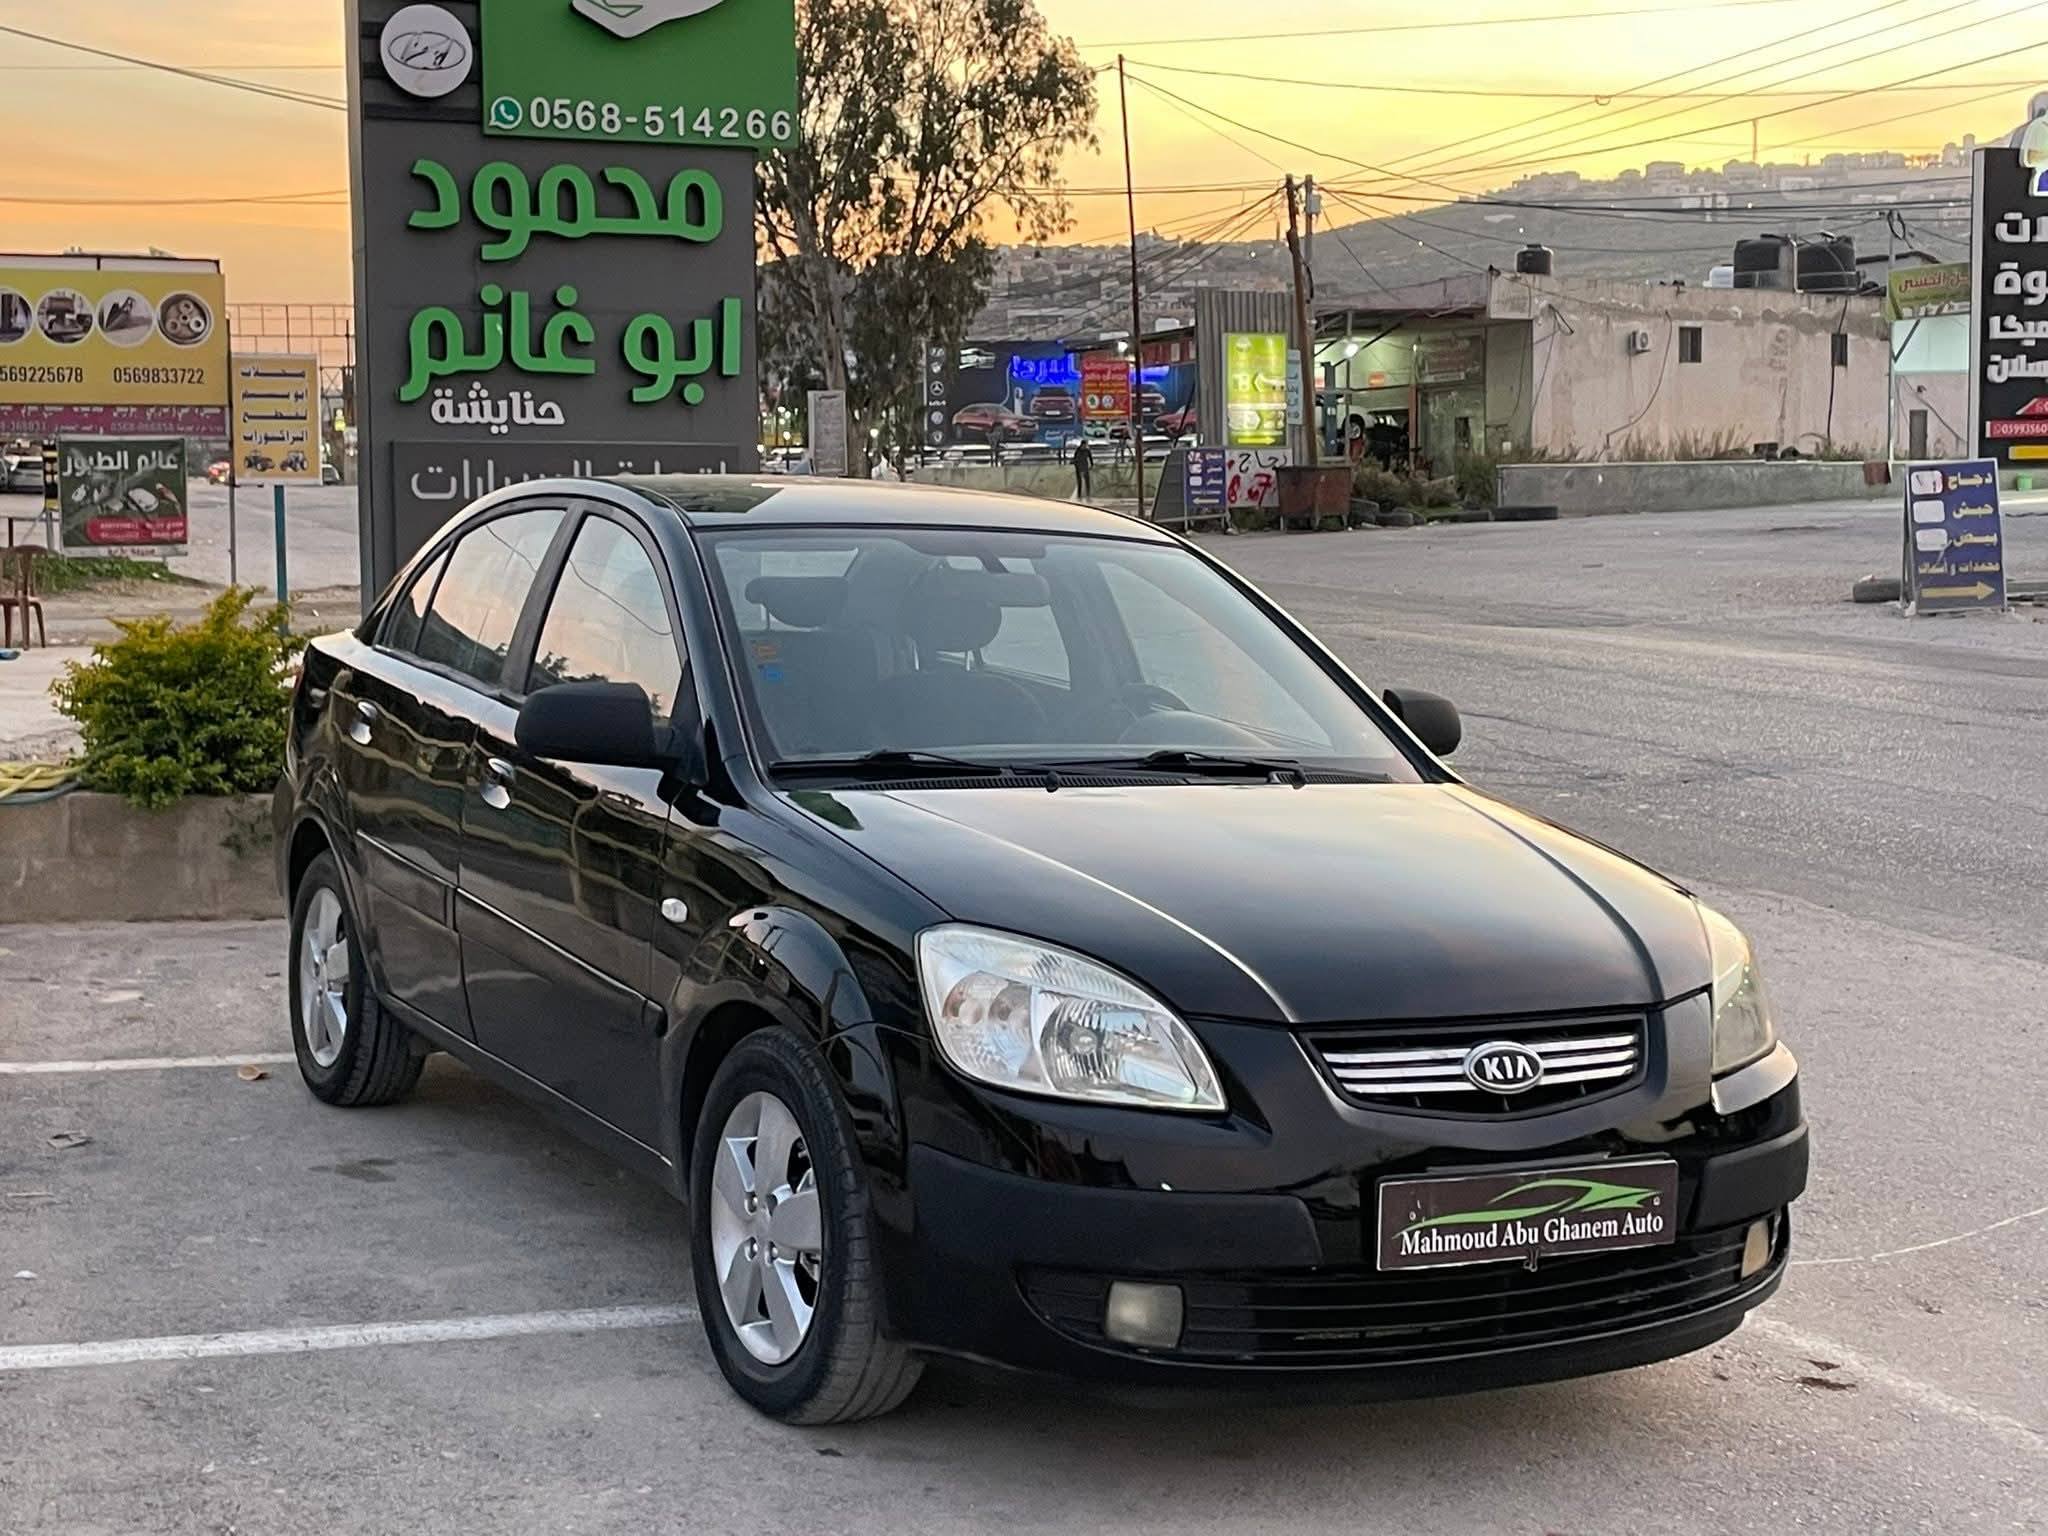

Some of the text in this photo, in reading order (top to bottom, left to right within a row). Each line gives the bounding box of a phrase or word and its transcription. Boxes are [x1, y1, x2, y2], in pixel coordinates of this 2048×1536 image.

[530, 97, 791, 140] 0568-514266
[407, 159, 724, 262] محمود
[399, 283, 742, 407] ابو غانم
[113, 366, 205, 385] 0569833722
[430, 381, 566, 435] حنايشة
[62, 450, 179, 478] عالم الطيور
[1947, 472, 1993, 490] دجاج
[1952, 501, 1994, 519] حبش
[1481, 1055, 1534, 1081] KIA
[1400, 1212, 1664, 1256] Mahmoud Abu Ghanem Auto
